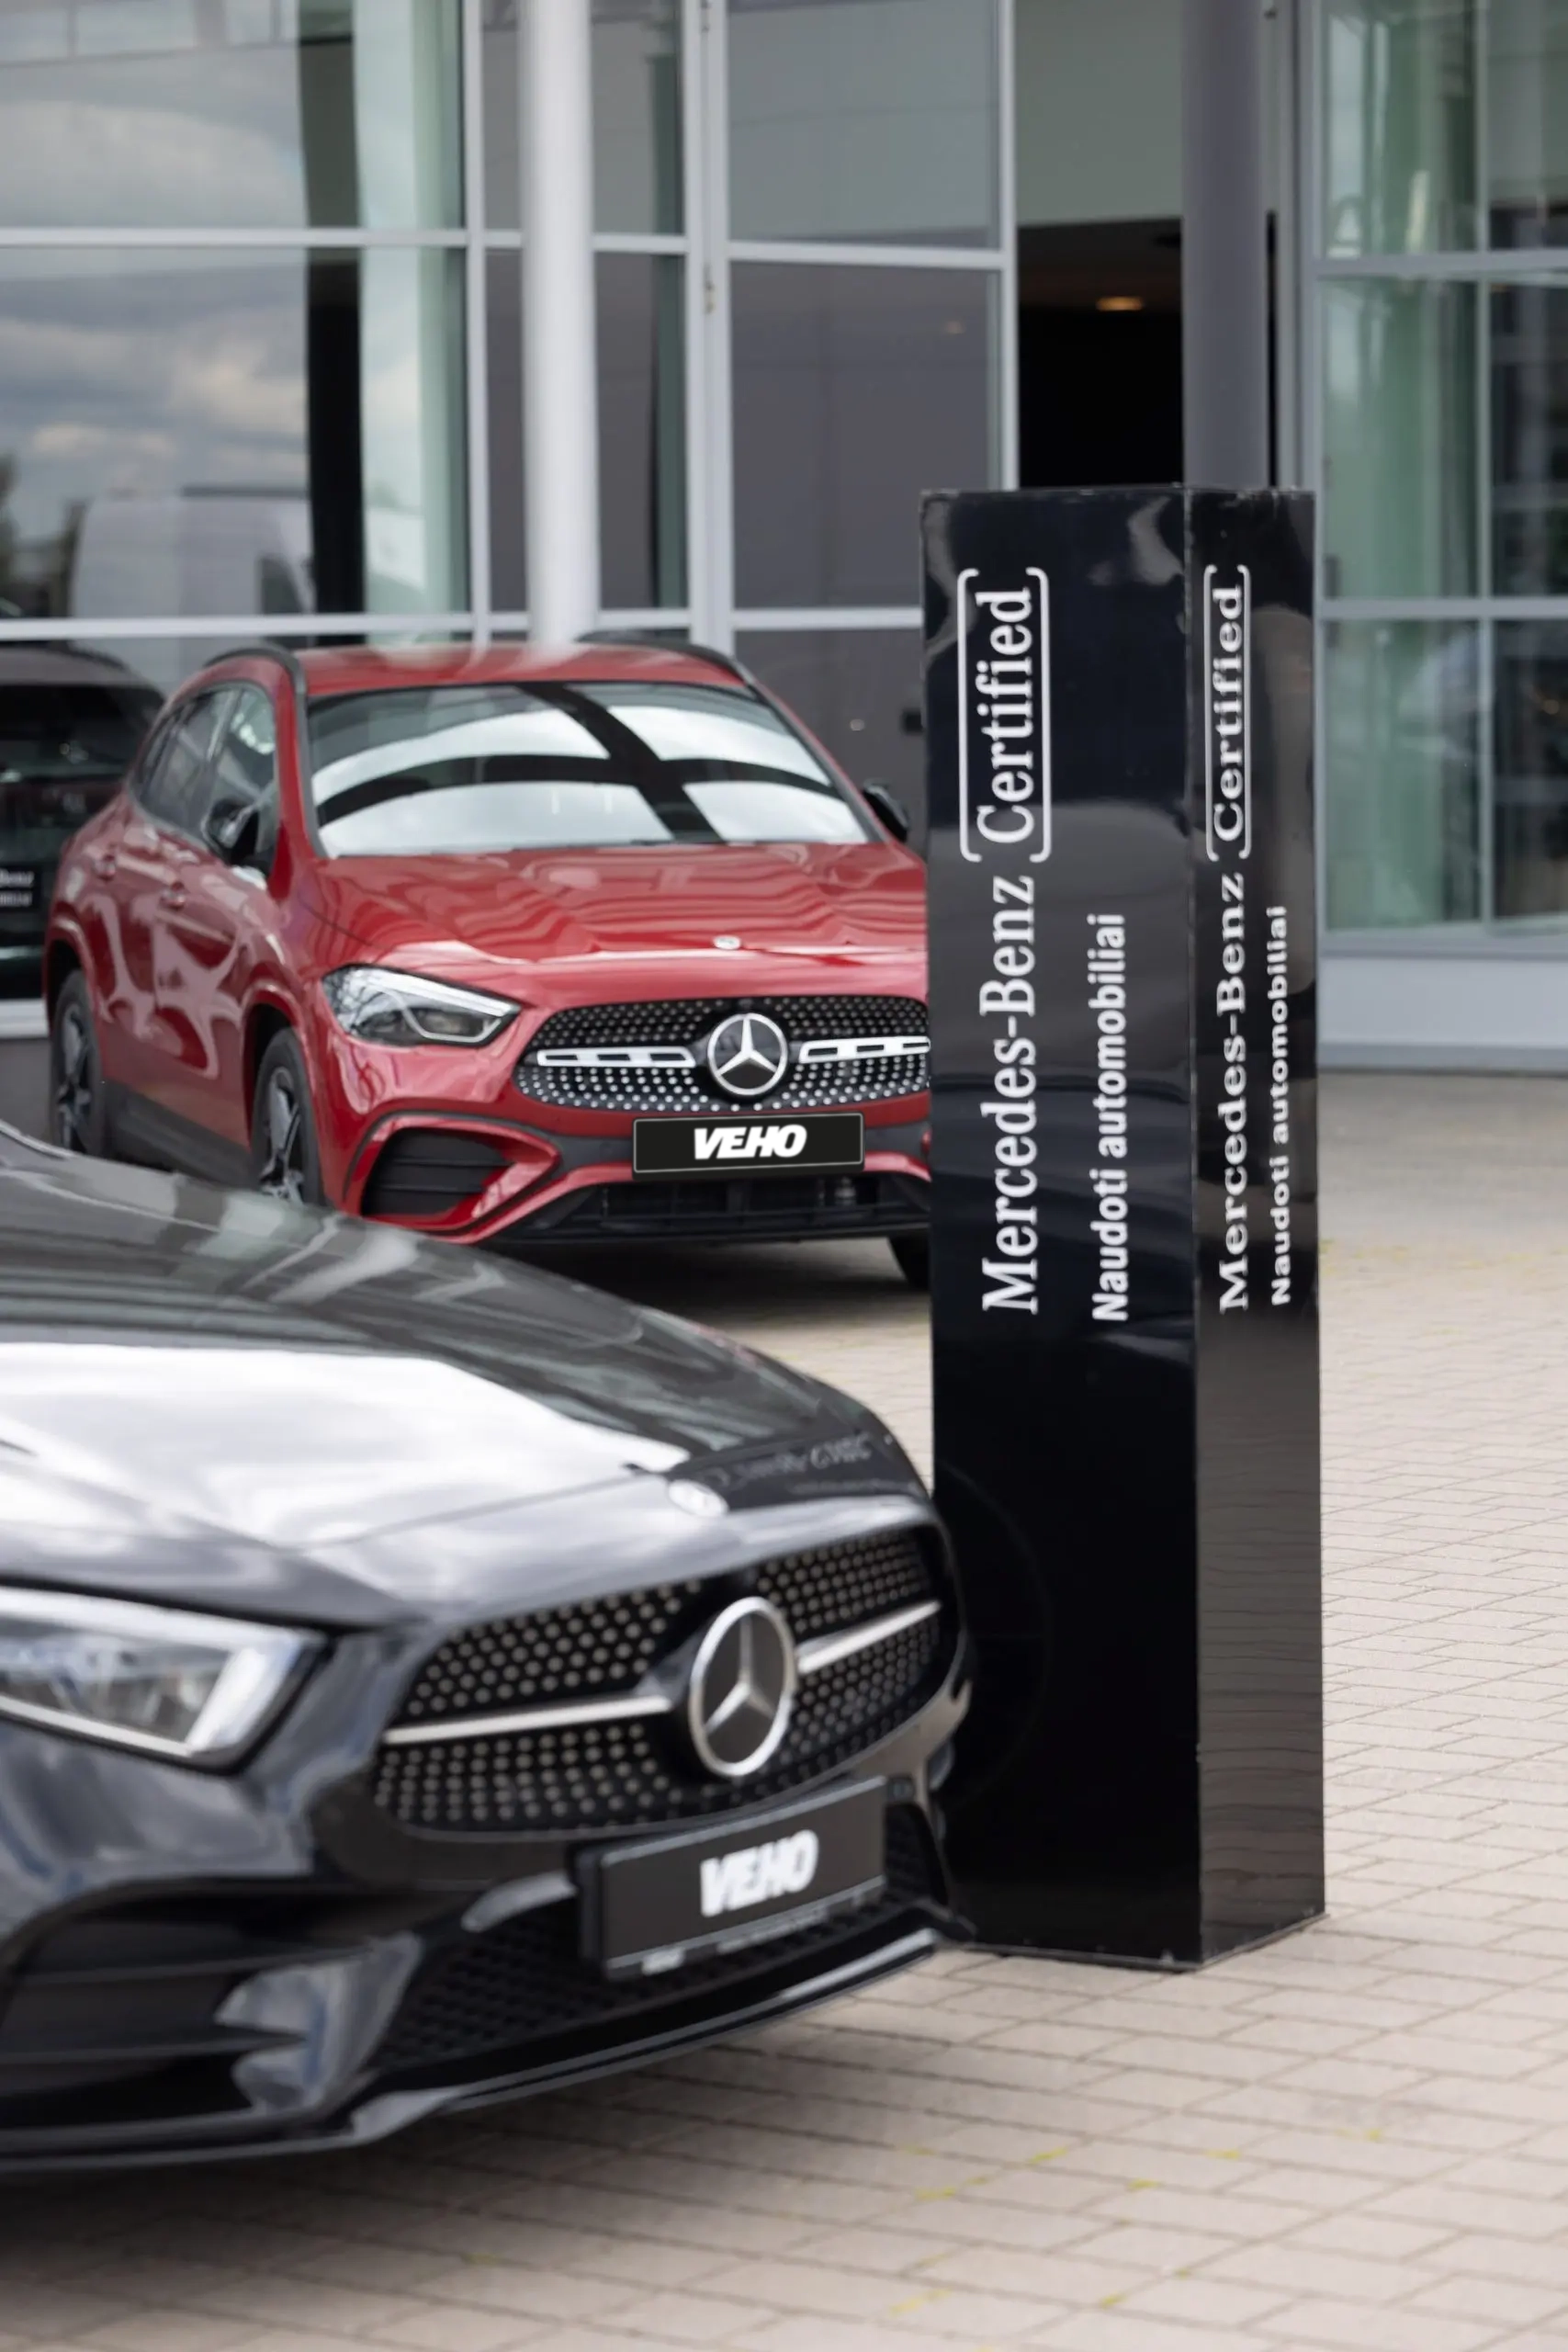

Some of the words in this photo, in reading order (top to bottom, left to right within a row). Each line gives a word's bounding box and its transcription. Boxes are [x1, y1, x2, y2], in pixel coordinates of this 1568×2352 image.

[979, 875, 1038, 1313] Mercedes-Benz
[1087, 913, 1127, 1159] automobiliai
[1216, 872, 1248, 1313] Mercedes-Benz
[1266, 905, 1290, 1145] automobiliai
[694, 1124, 807, 1159] VEHO
[1269, 1155, 1291, 1306] Naudoti
[1089, 1168, 1129, 1320] Naudoti
[700, 1829, 818, 1917] VEHO
